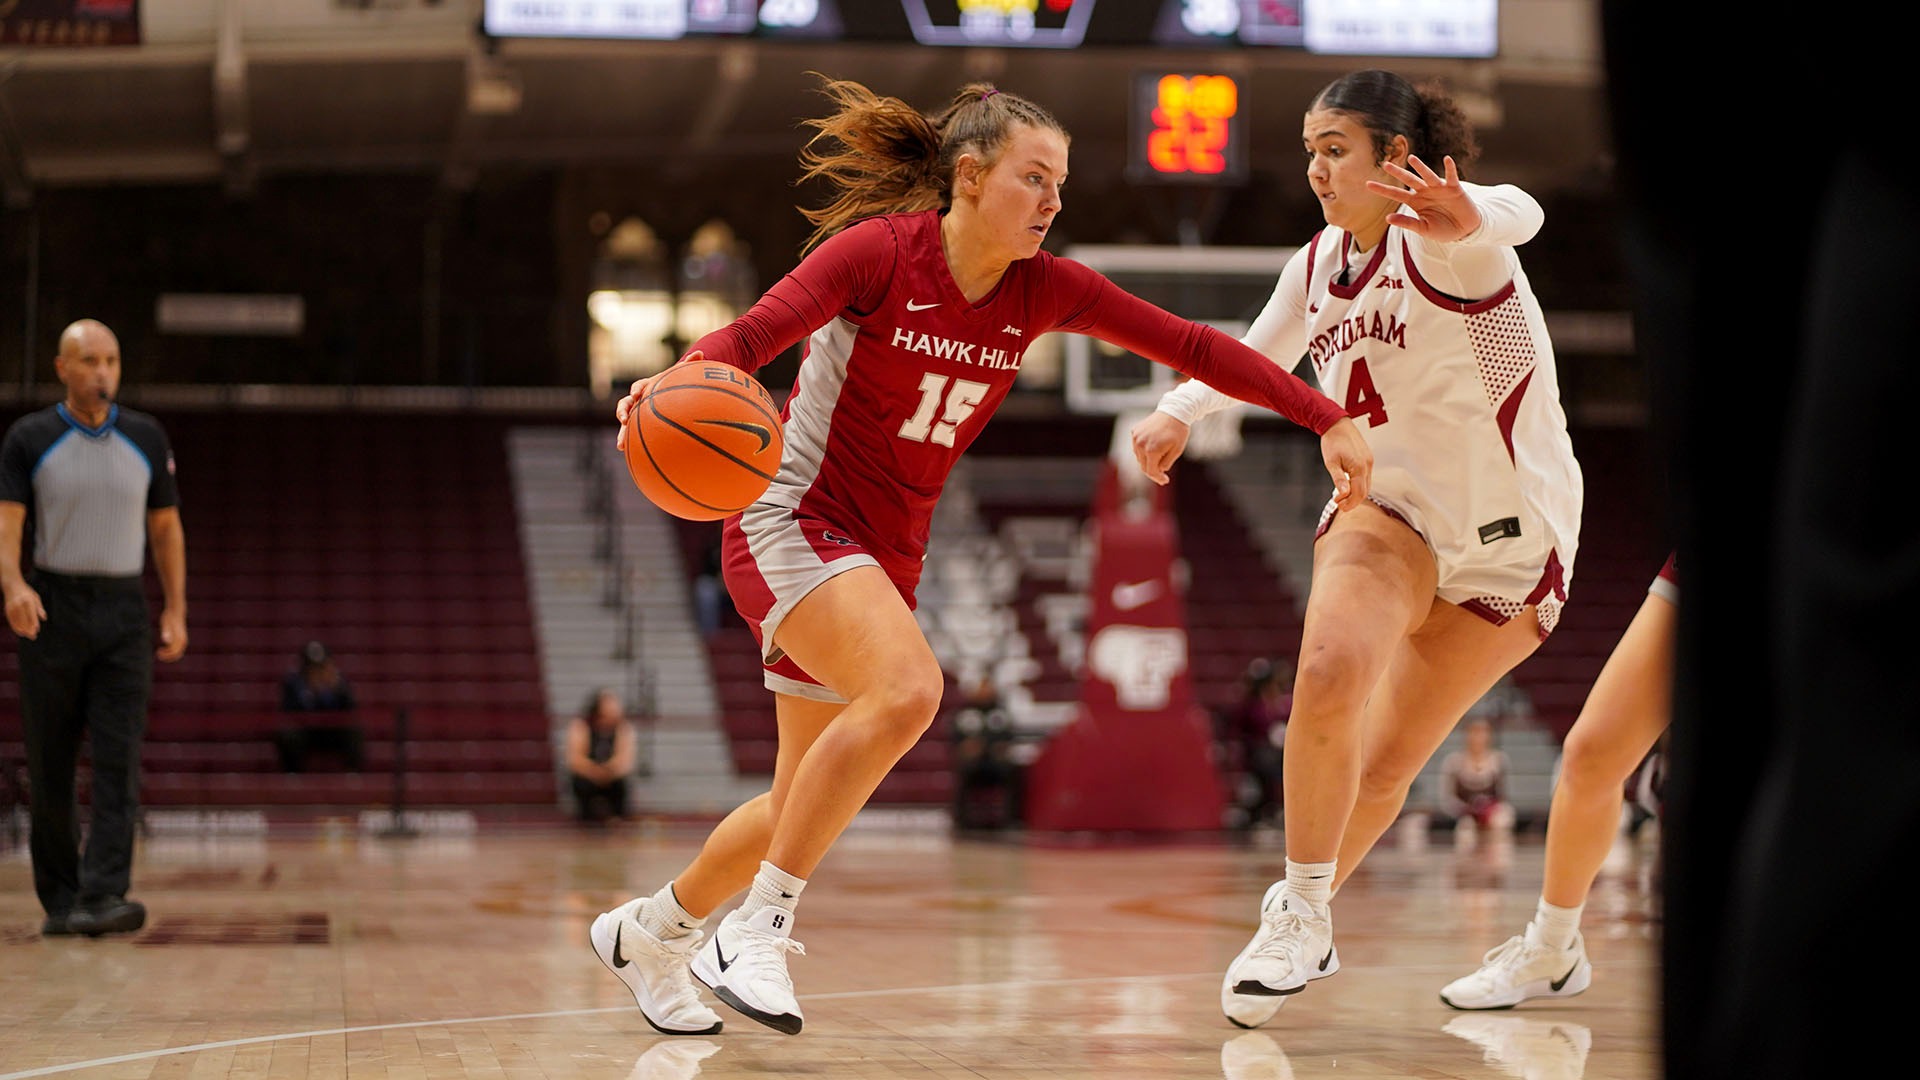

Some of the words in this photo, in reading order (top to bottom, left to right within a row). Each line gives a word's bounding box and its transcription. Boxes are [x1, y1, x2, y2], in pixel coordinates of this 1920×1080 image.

[891, 327, 977, 364] HAWK
[978, 346, 1021, 370] HILL
[1309, 310, 1406, 371] FORDHAM
[897, 372, 991, 448] 15
[1345, 356, 1389, 429] 4
[772, 914, 785, 929] S
